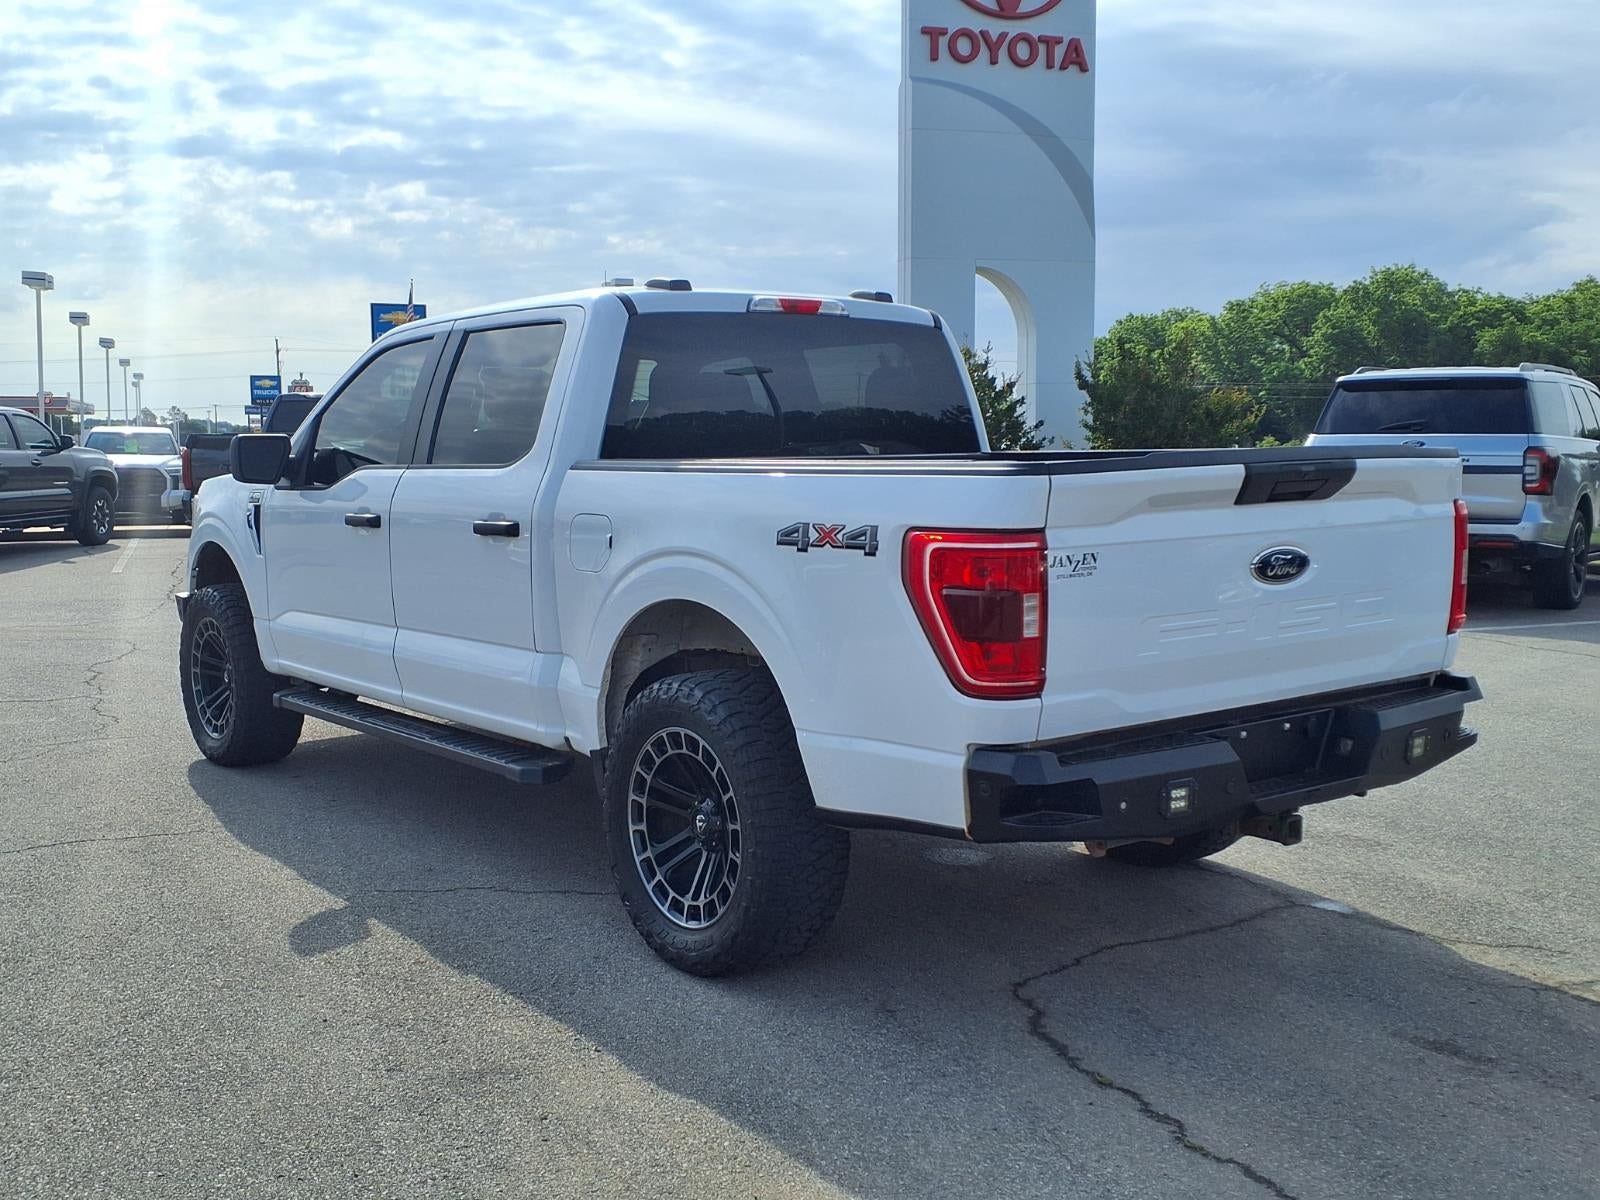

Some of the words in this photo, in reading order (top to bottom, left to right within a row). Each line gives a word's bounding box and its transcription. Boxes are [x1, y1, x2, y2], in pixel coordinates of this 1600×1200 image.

[921, 26, 1090, 73] TOYOTA
[1049, 551, 1100, 573] JANZEN
[1267, 553, 1301, 577] Ford
